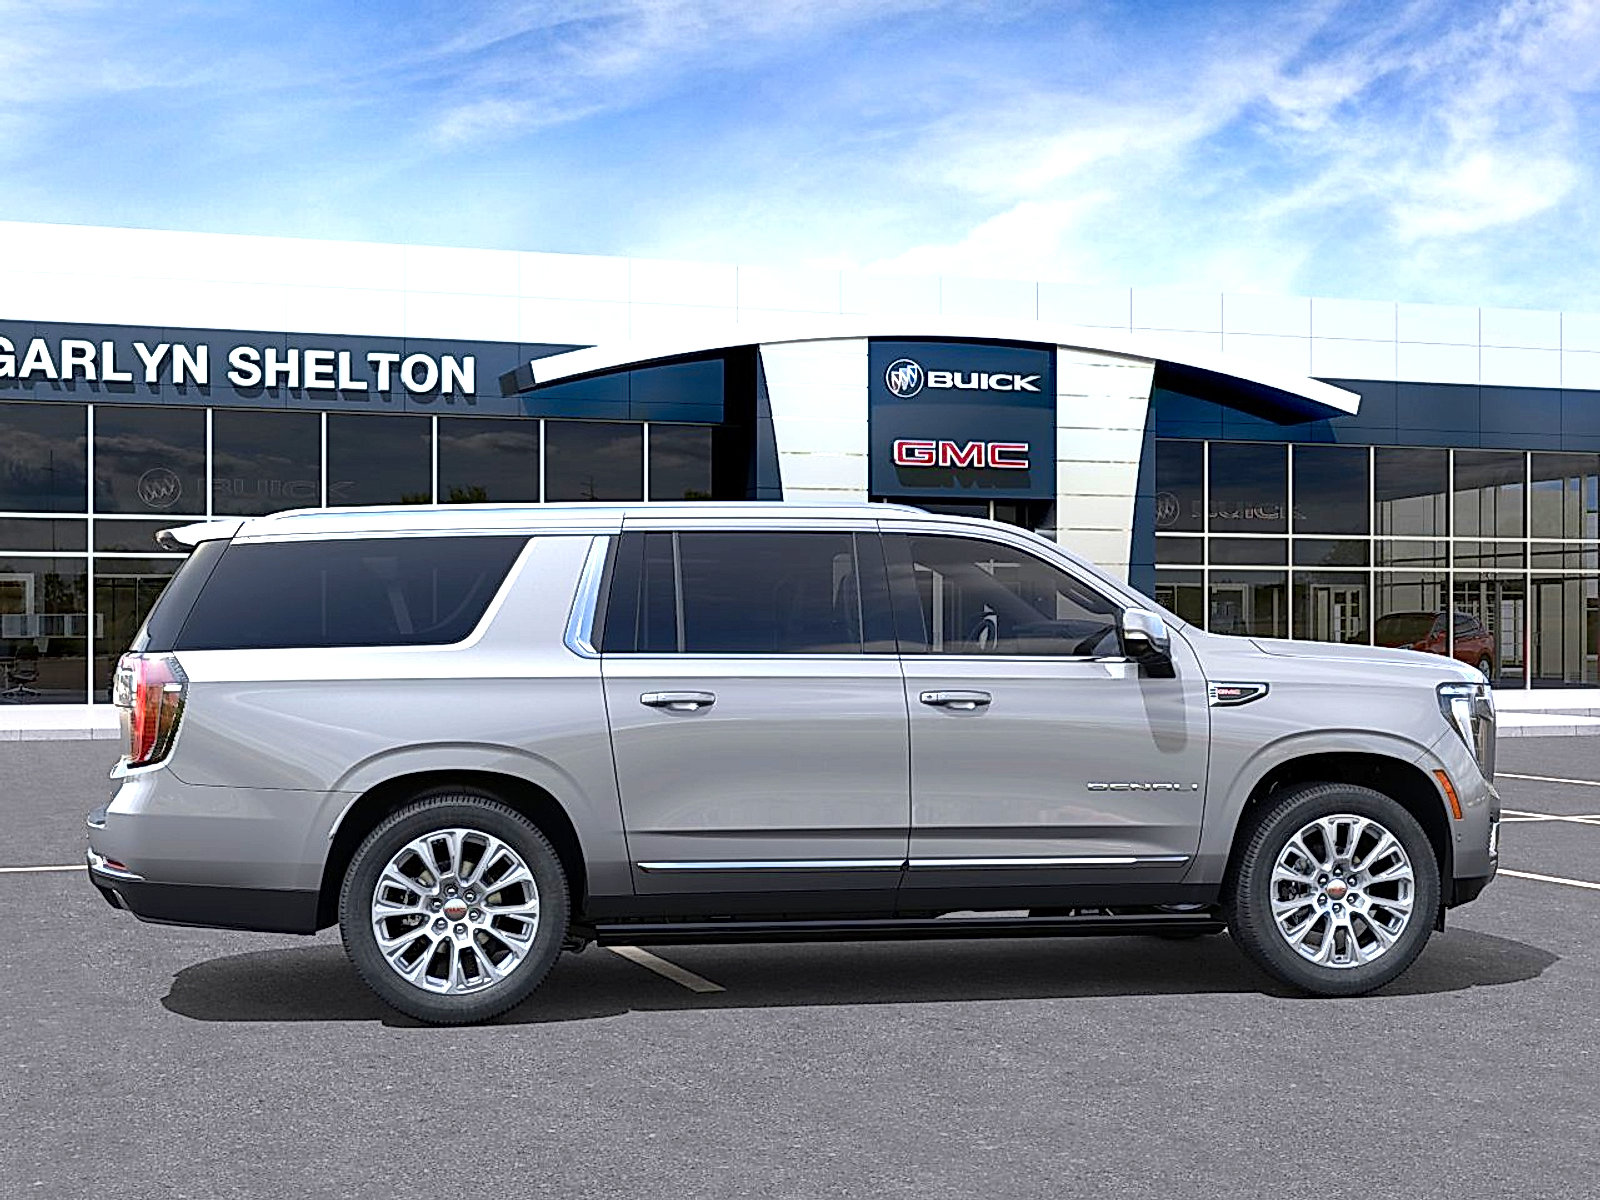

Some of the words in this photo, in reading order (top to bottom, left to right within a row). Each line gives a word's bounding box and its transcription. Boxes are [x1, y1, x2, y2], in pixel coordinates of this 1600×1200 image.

[228, 347, 475, 393] SHELTON
[927, 371, 1041, 391] BUICK
[893, 440, 1029, 469] GMC
[1087, 782, 1198, 791] DENALI
